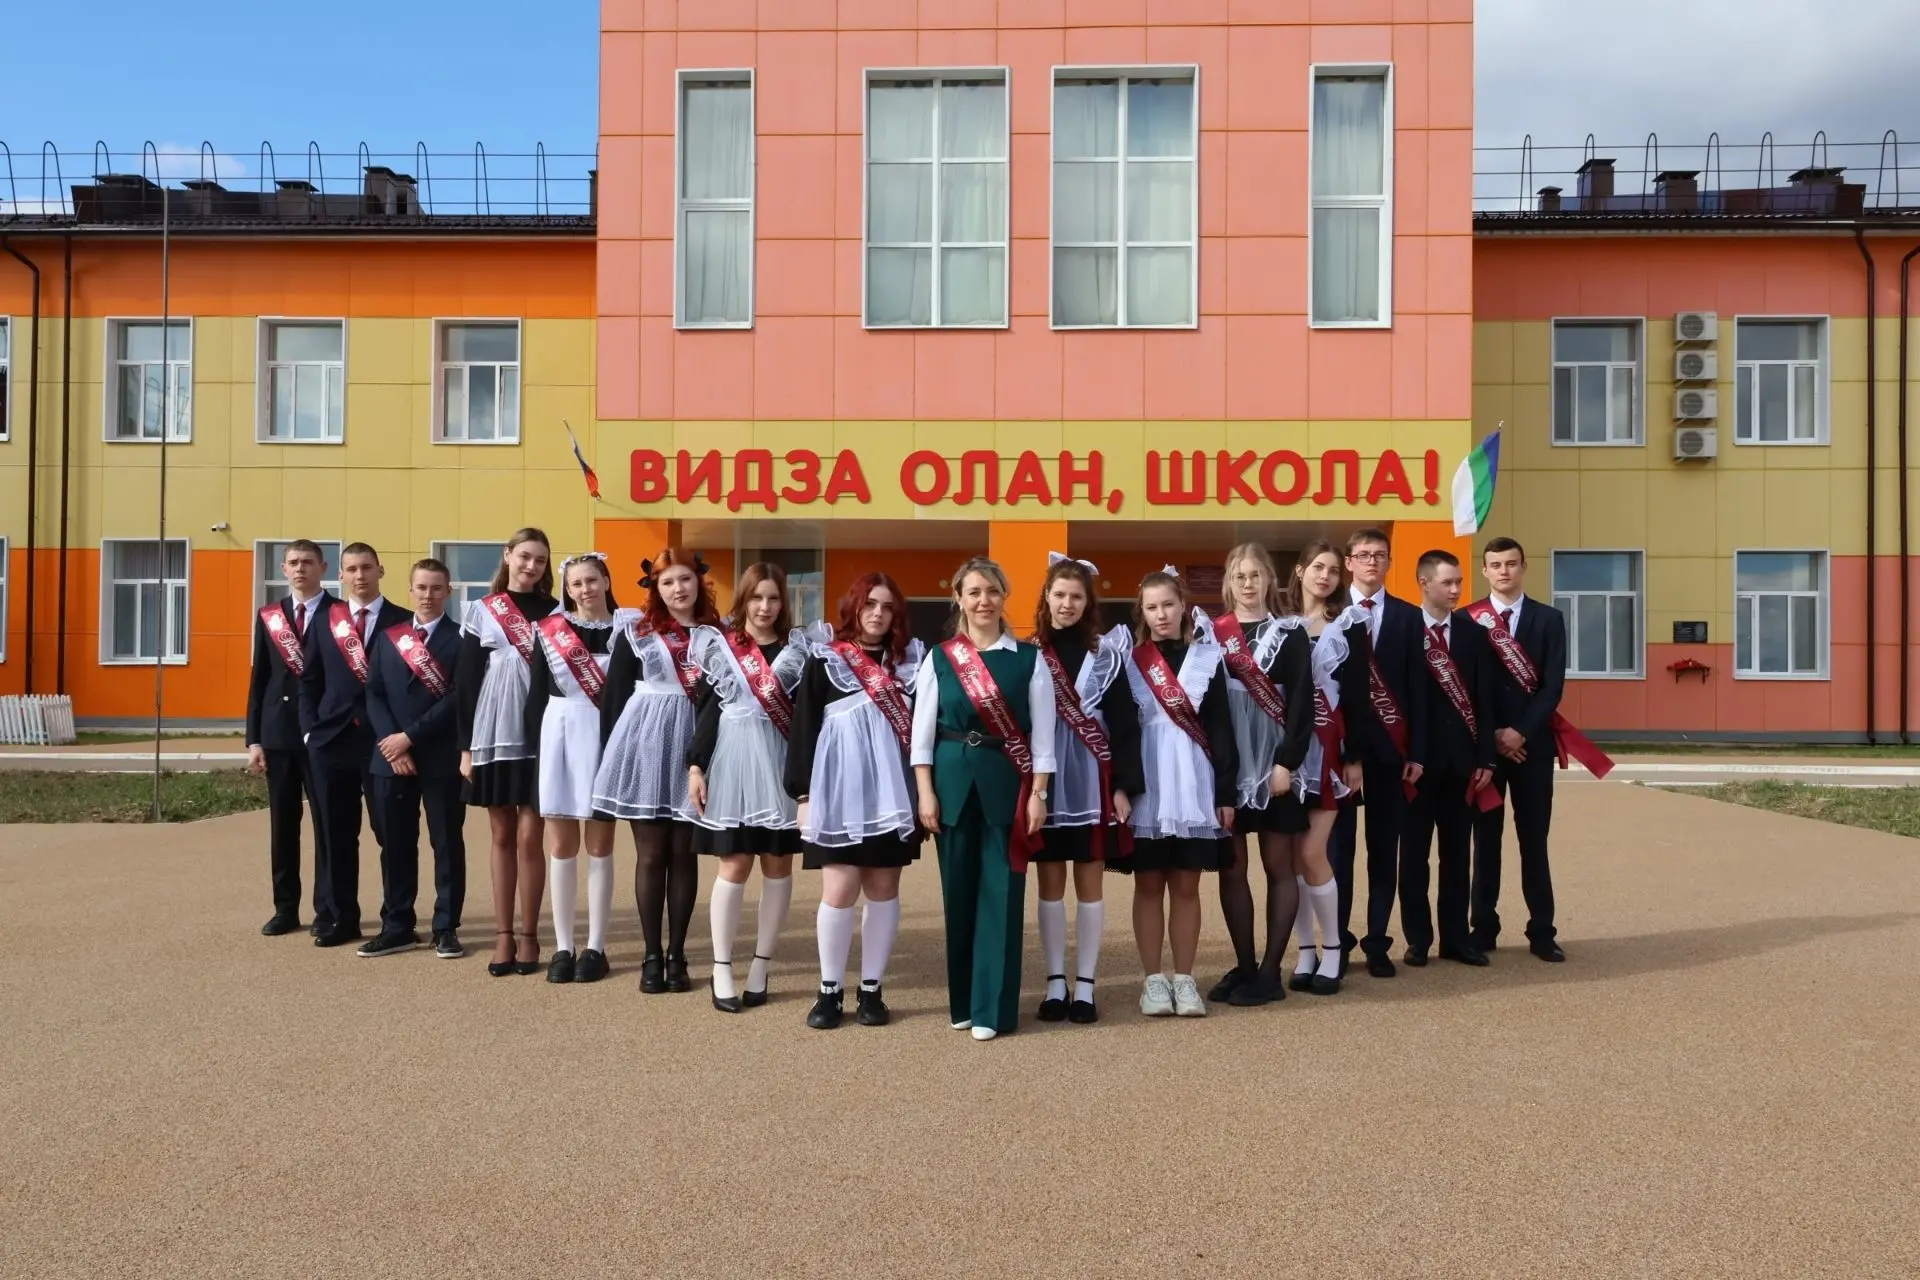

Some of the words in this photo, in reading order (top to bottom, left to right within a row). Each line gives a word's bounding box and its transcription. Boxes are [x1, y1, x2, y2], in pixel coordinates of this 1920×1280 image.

[631, 449, 870, 511] ВИДЗА
[901, 450, 1123, 514] ОЛАН,
[1146, 450, 1440, 505] ШКОЛА!
[1426, 649, 1465, 703] Выпускник
[1491, 627, 1531, 679] Выпускник
[1369, 690, 1402, 723] 2026
[1003, 735, 1032, 772] 2026
